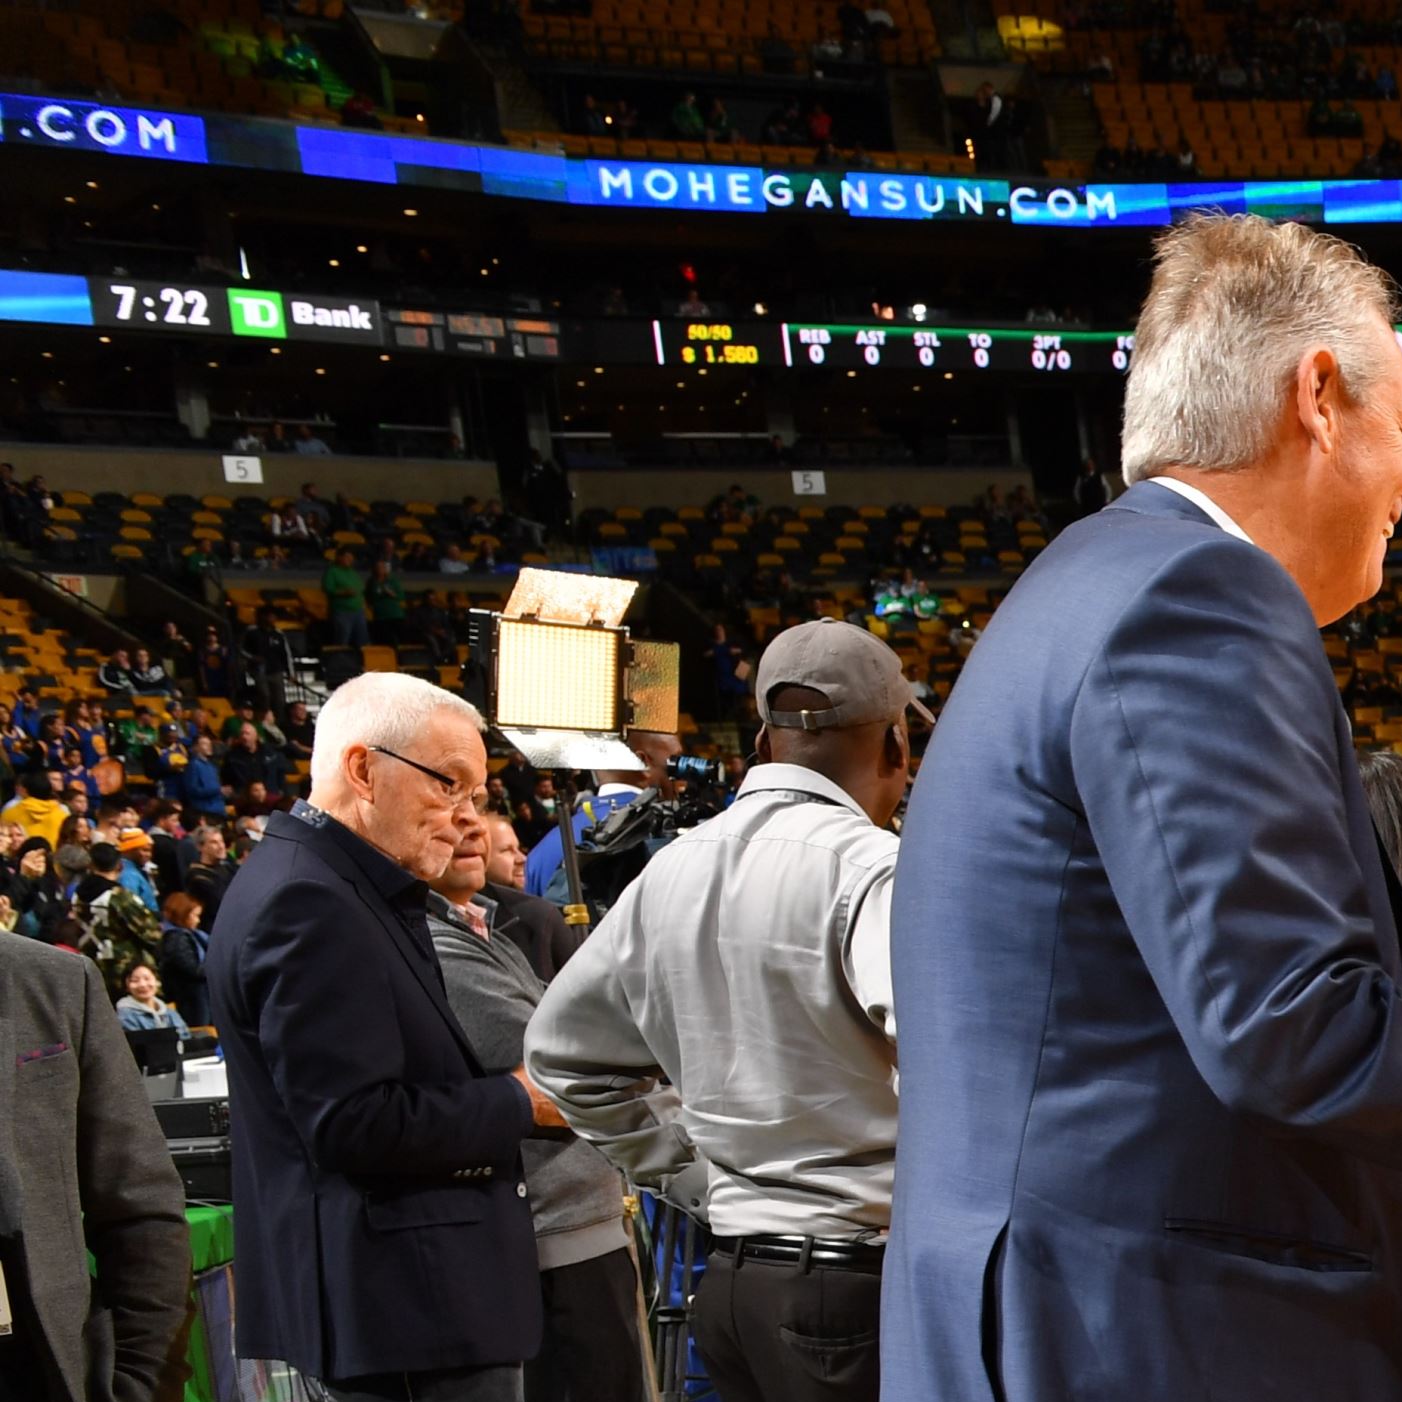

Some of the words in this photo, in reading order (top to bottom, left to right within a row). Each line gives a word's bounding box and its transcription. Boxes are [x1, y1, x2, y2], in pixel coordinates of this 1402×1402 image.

[600, 166, 1118, 220] MOHEGANSUN.COM
[110, 285, 211, 326] 7:22
[234, 297, 280, 329] TD
[291, 301, 374, 330] Bank
[688, 324, 733, 341] 50/50
[799, 328, 832, 344] REB
[856, 330, 887, 346] AST
[913, 332, 942, 348] STL
[968, 333, 993, 349] TO
[1033, 335, 1062, 350] 3PT
[809, 344, 825, 365] 0
[864, 345, 880, 366] 0
[919, 347, 935, 367] 0
[974, 348, 990, 369] 0
[1031, 350, 1072, 371] 0/0
[235, 460, 249, 479] 5
[802, 473, 814, 492] 5
